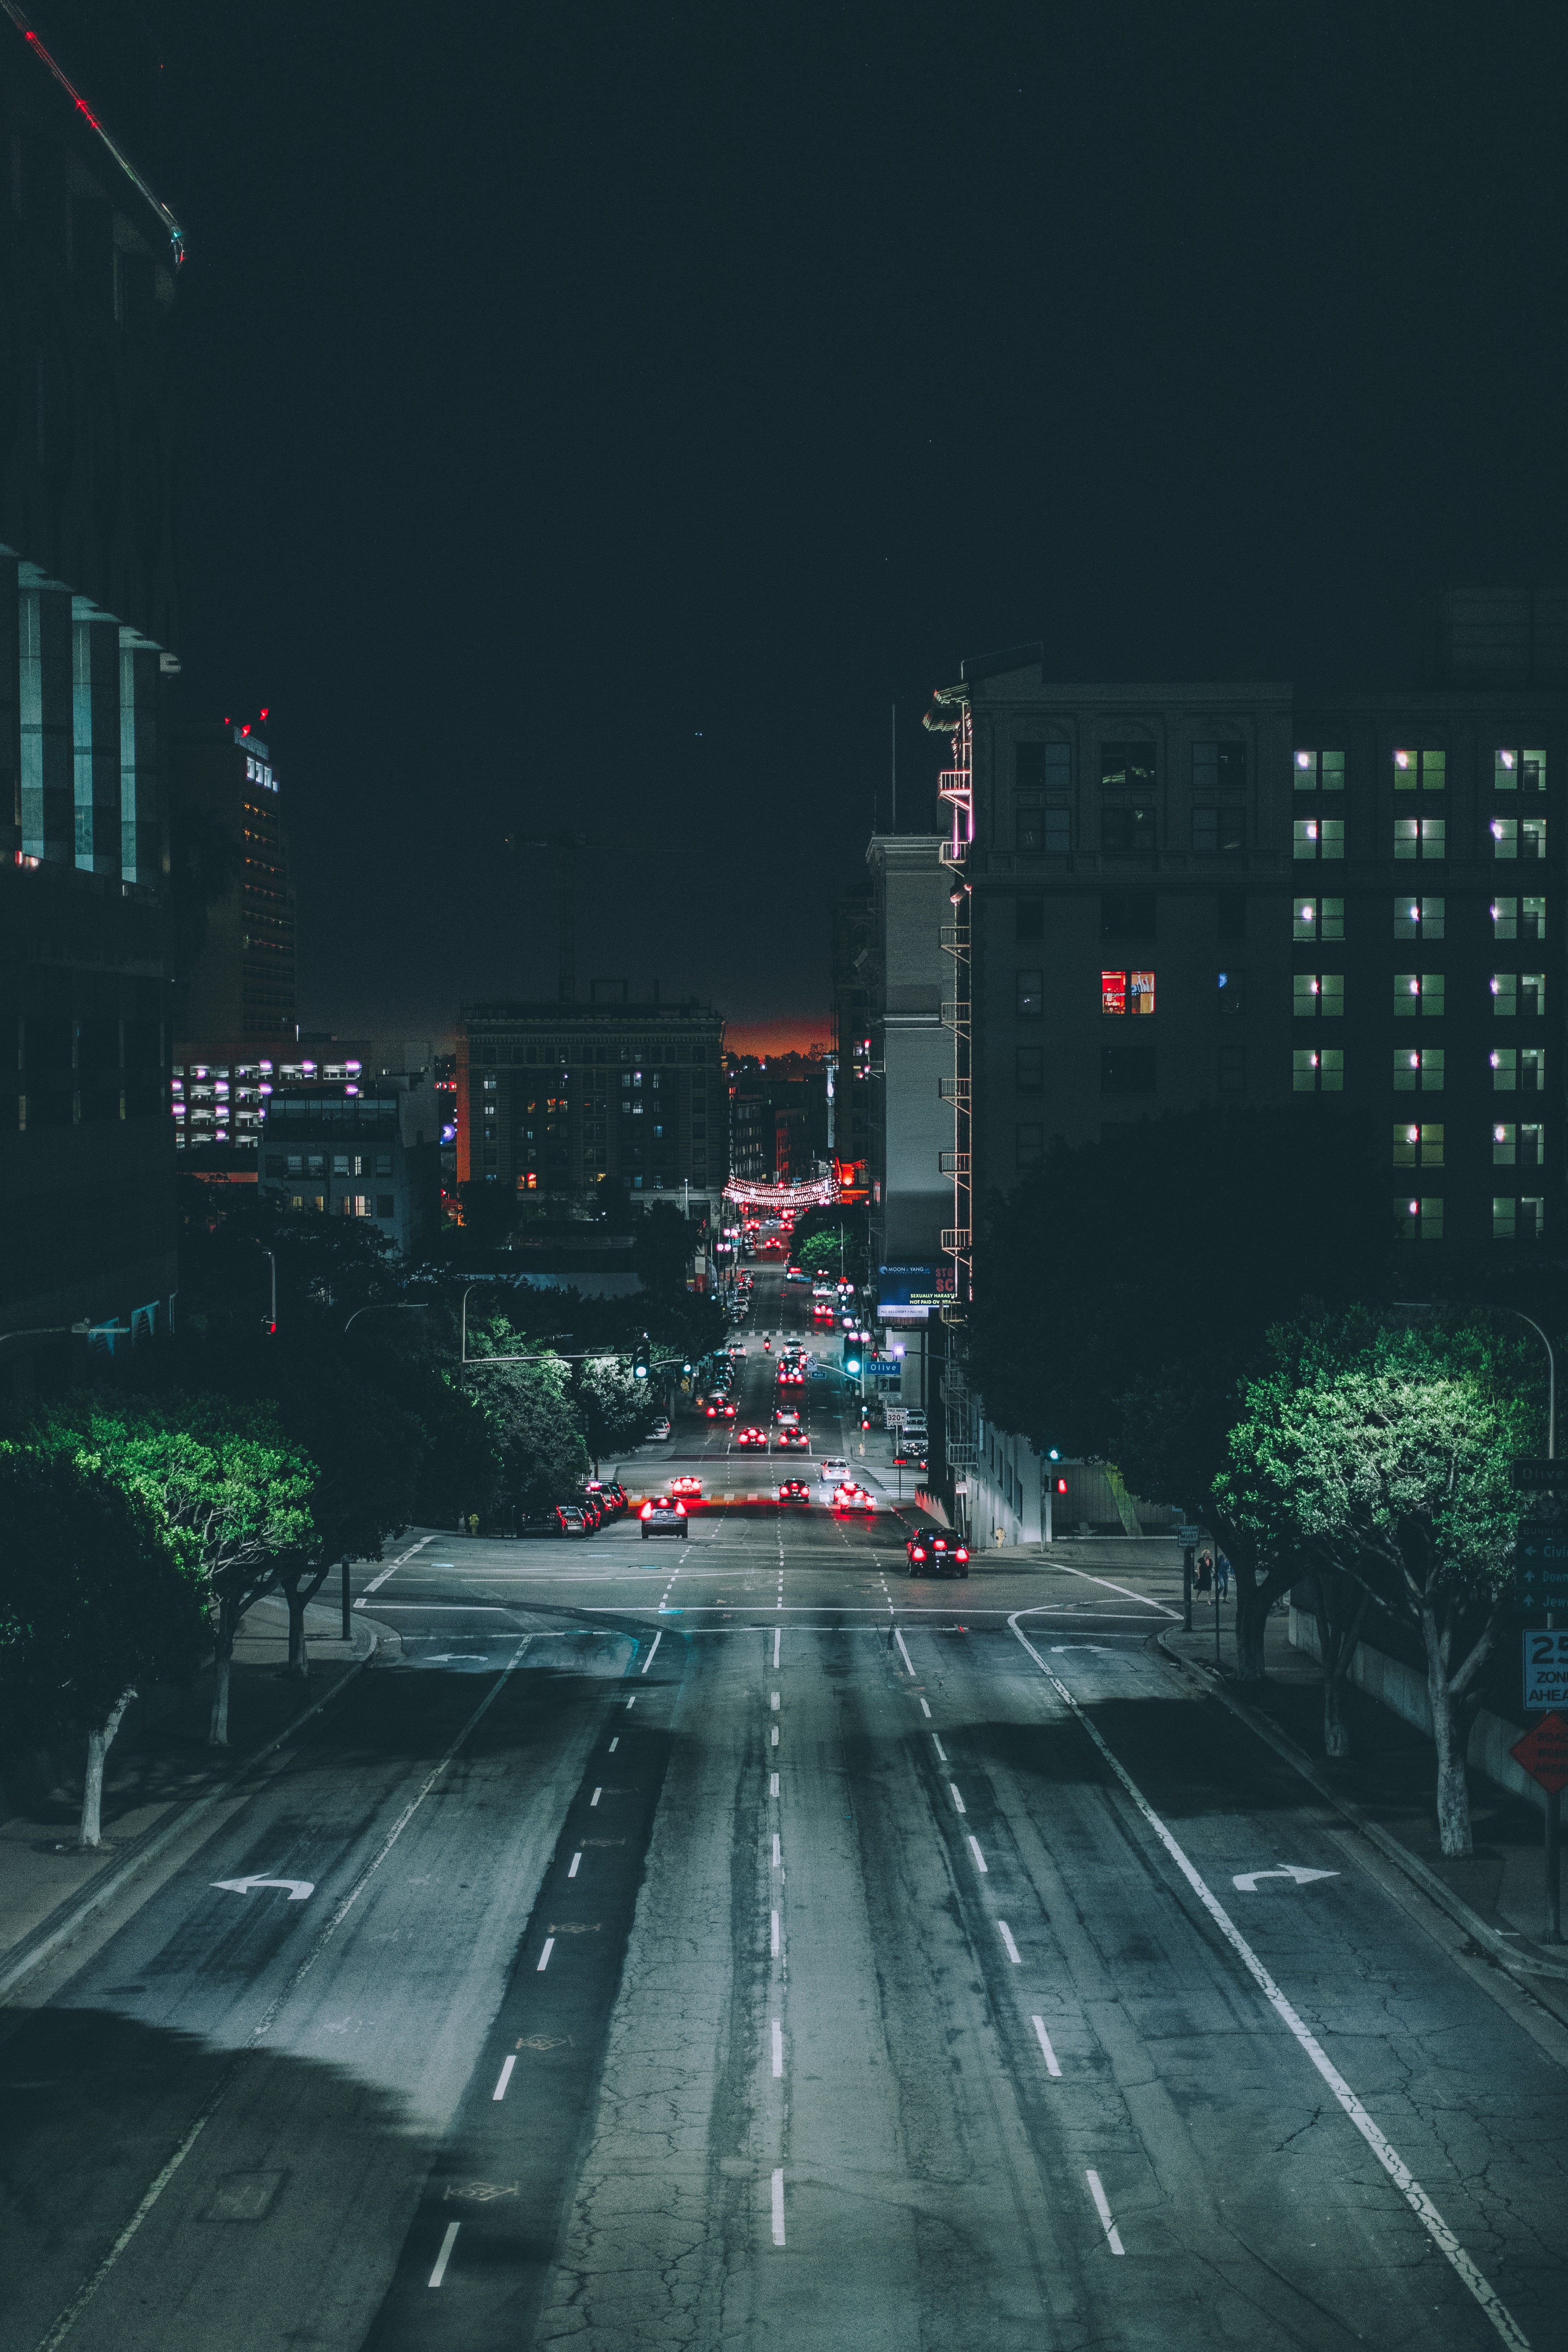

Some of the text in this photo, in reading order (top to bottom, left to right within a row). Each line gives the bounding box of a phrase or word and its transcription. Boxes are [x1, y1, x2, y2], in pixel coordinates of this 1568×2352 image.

[1523, 1467, 1564, 1480] Olive
[1543, 1545, 1568, 1558] Civi
[1542, 1595, 1568, 1607] Jew
[1536, 1671, 1568, 1684] ZON
[1534, 1763, 1568, 1774] AHEA
